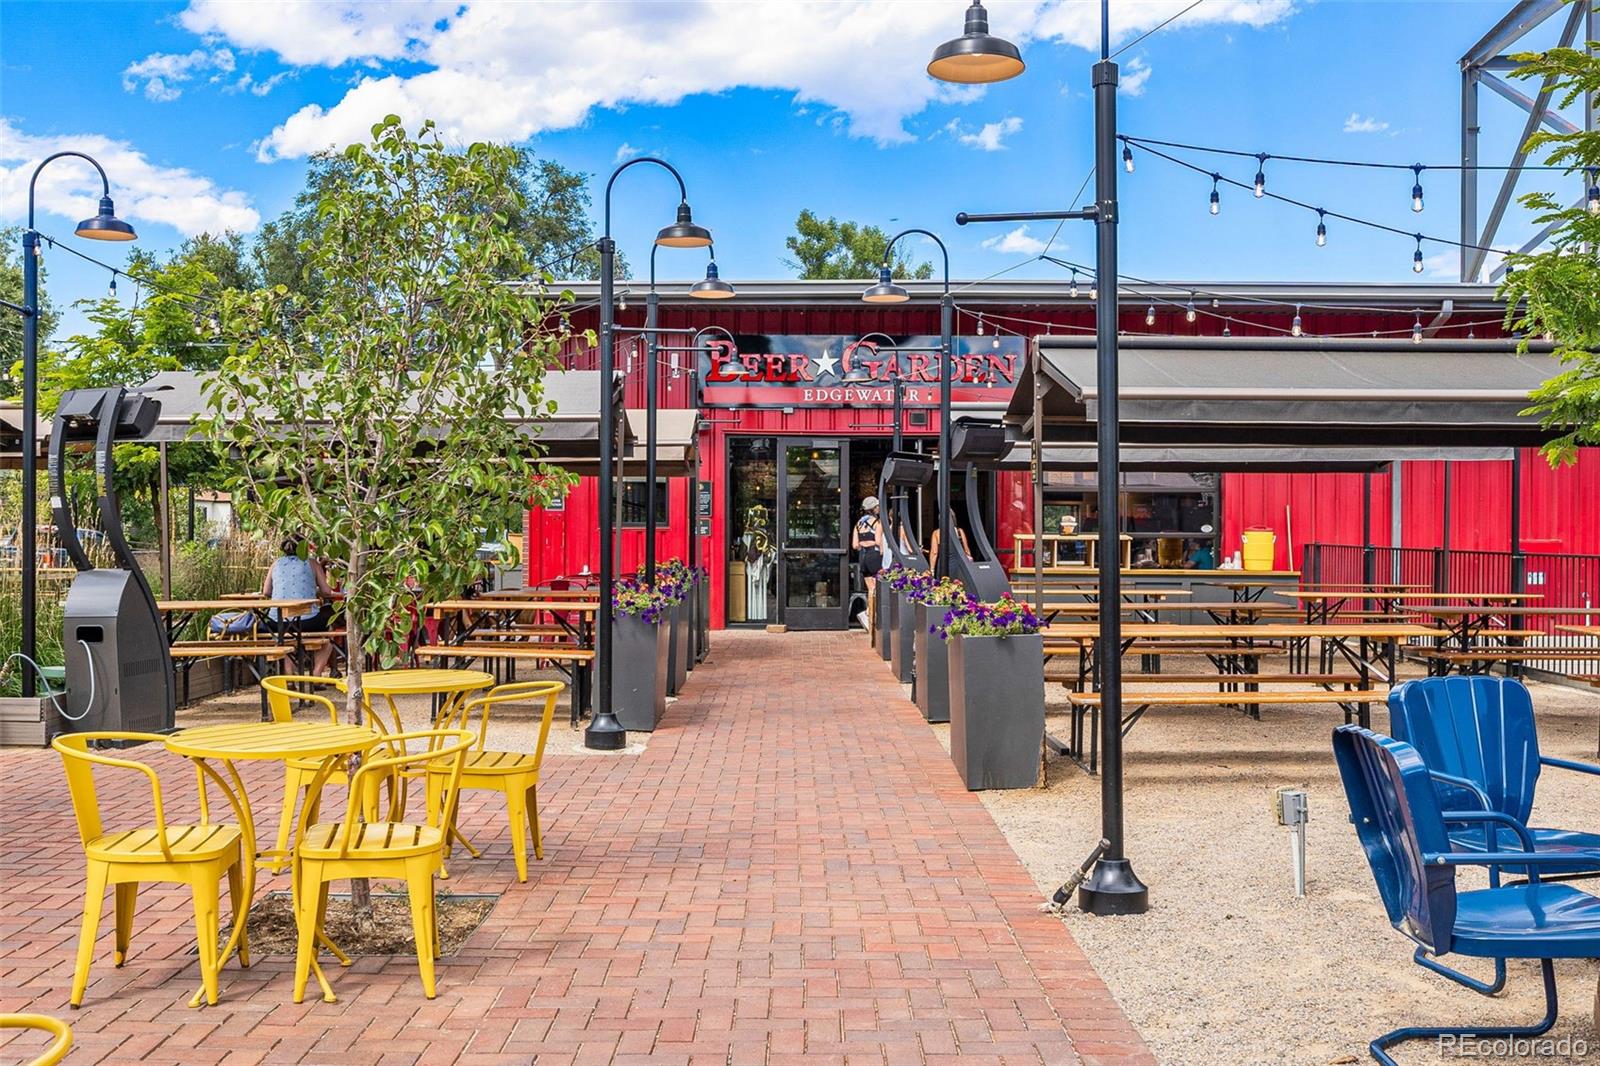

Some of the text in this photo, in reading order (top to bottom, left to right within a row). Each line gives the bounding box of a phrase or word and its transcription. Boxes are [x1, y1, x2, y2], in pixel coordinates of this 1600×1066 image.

[705, 340, 1018, 383] BEER GARDEN
[803, 389, 919, 401] EDGEWATR
